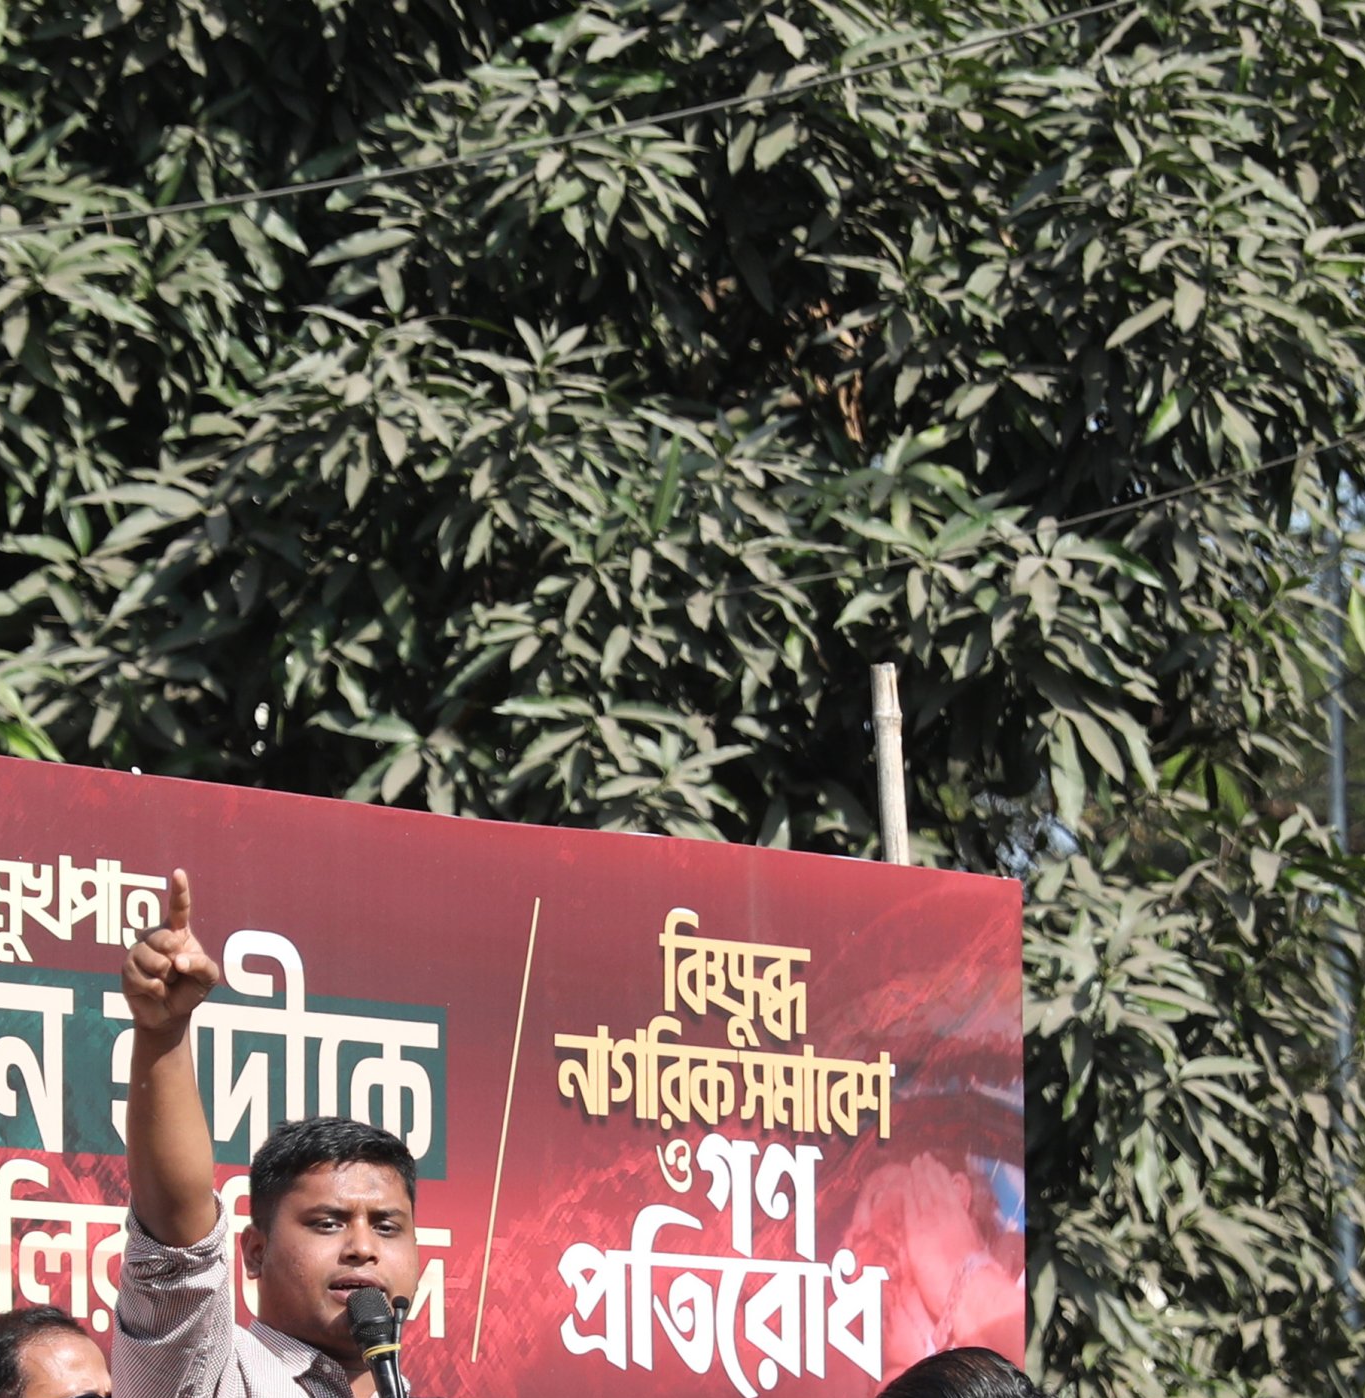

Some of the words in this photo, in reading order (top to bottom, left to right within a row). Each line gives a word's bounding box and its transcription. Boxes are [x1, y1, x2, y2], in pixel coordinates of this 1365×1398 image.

[554, 1016, 737, 1130] নাগরিক
[737, 1045, 896, 1139] সমাবেশ
[657, 1139, 693, 1194] ও
[696, 1133, 824, 1262] গণ
